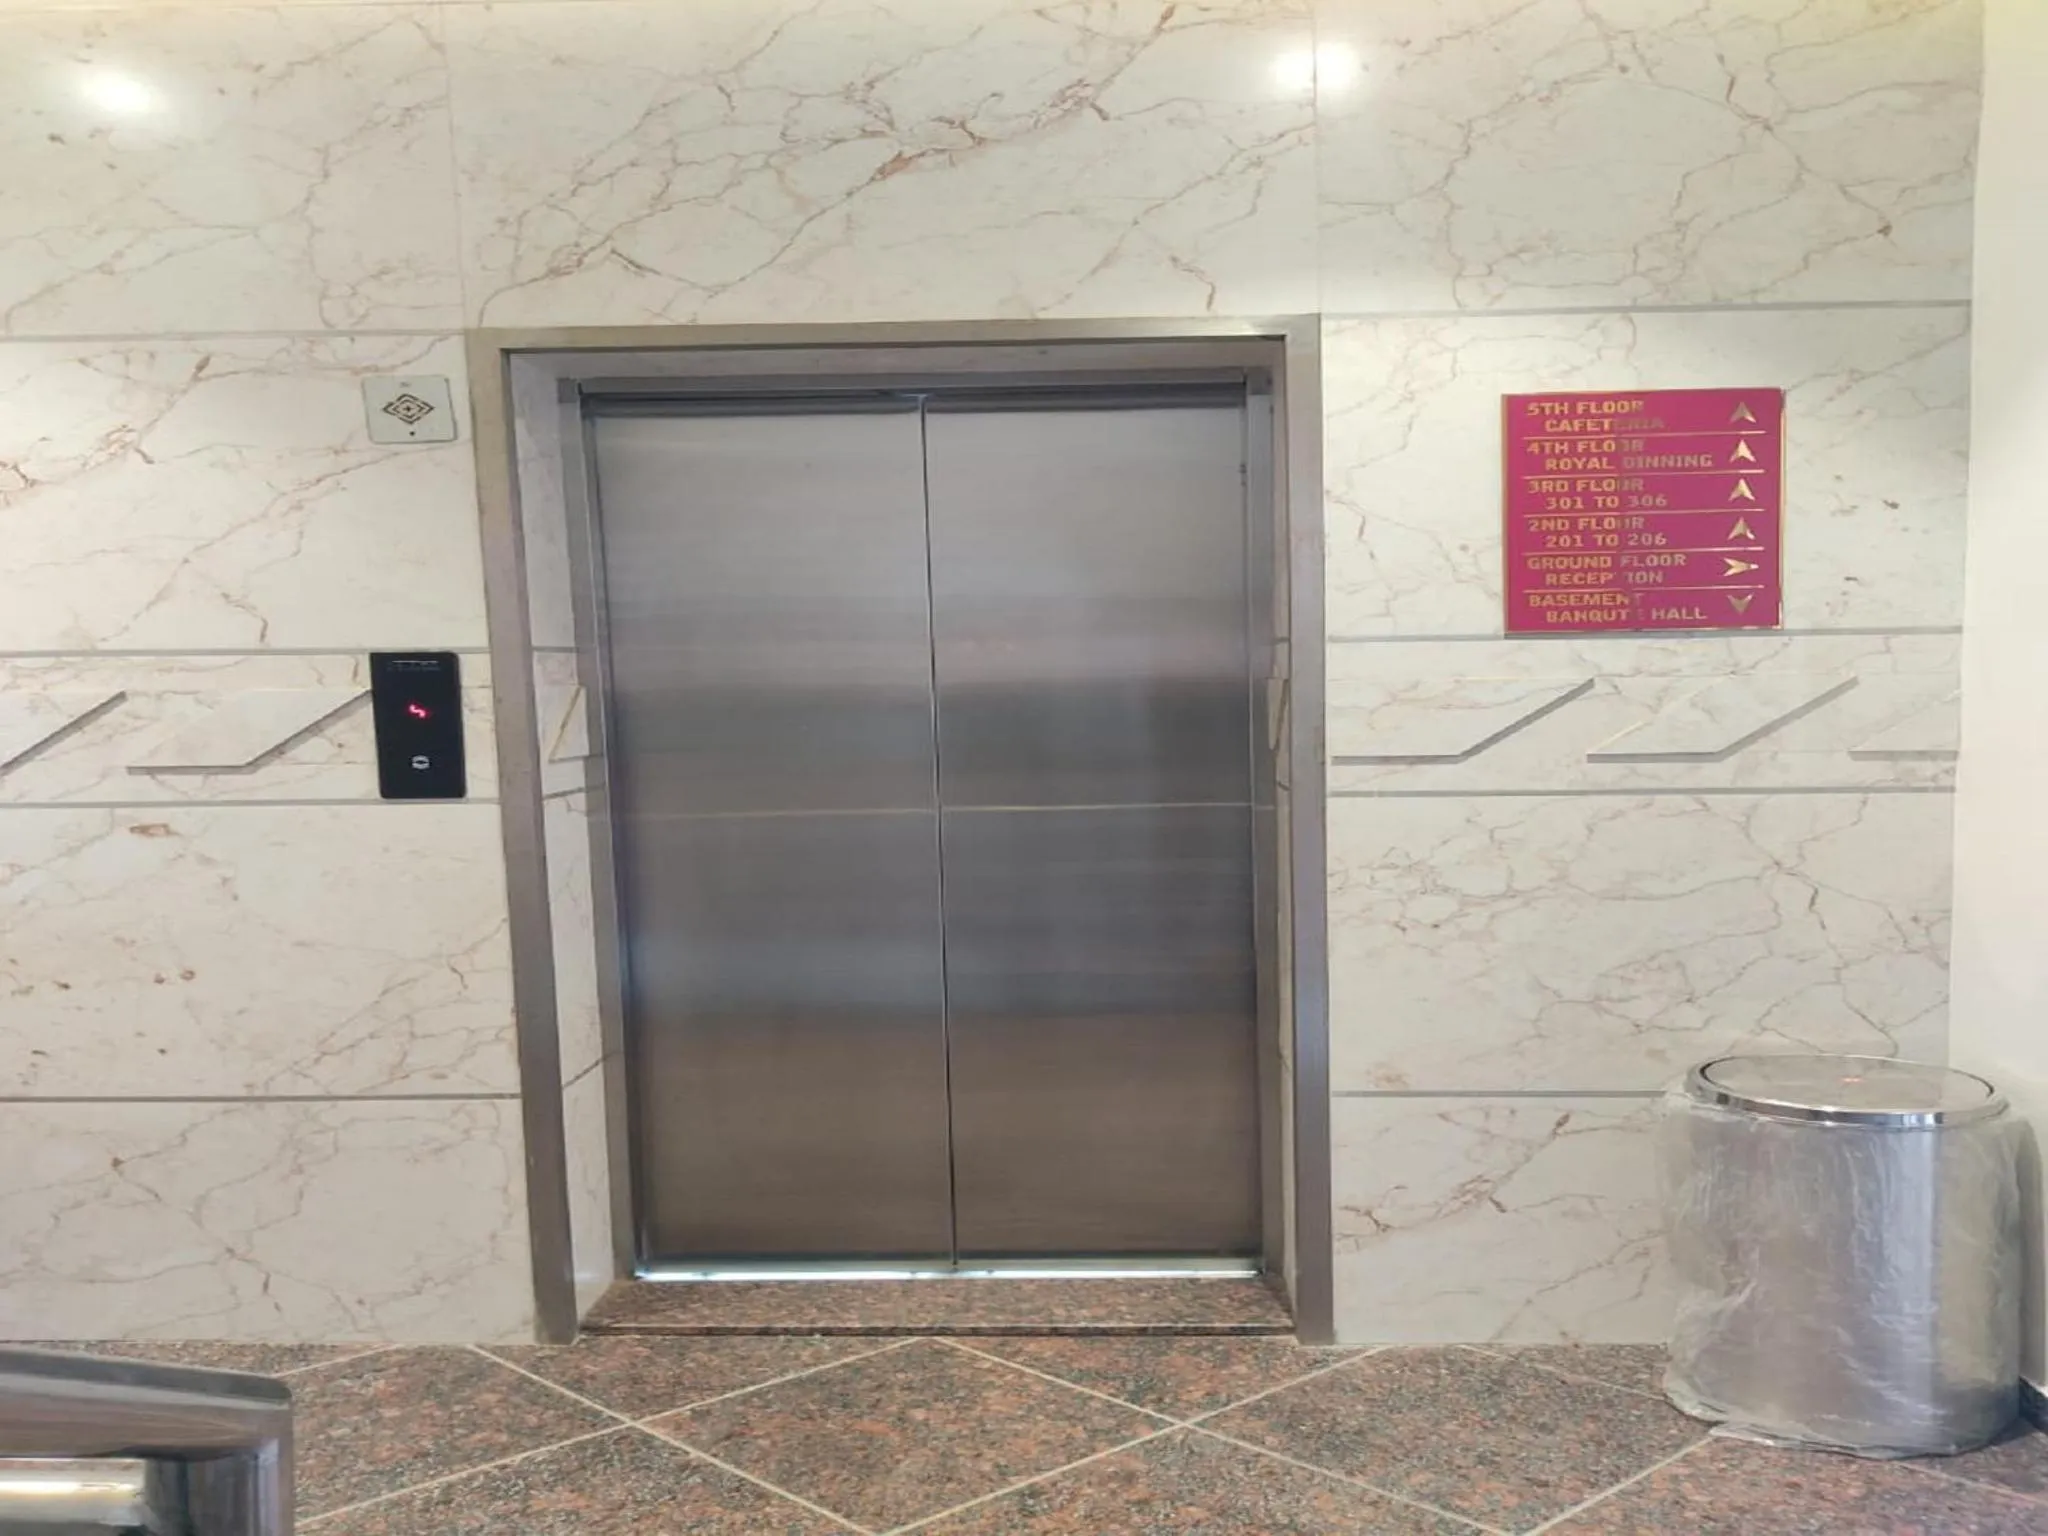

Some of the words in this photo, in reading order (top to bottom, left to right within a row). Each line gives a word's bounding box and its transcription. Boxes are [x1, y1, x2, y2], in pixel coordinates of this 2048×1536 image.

[1527, 402, 1568, 415] 5TH
[1576, 400, 1643, 414] FLOOR
[1545, 418, 1664, 432] CAFETRIA
[1527, 440, 1568, 454] 4TH
[1545, 457, 1615, 471] ROYAL
[1623, 454, 1712, 468] DINNING
[1528, 479, 1569, 493] 3RD
[1545, 497, 1584, 510] 301
[1594, 496, 1619, 508] TO
[1627, 494, 1667, 507] 306
[1528, 518, 1570, 532] 2ND
[1545, 535, 1584, 548] 201
[1594, 534, 1619, 546] TO
[1627, 533, 1667, 546] 206
[1527, 556, 1612, 569] GROUND
[1620, 553, 1687, 567] FLOOR
[1545, 571, 1663, 585] RECEPION
[1652, 606, 1707, 620] HALL
